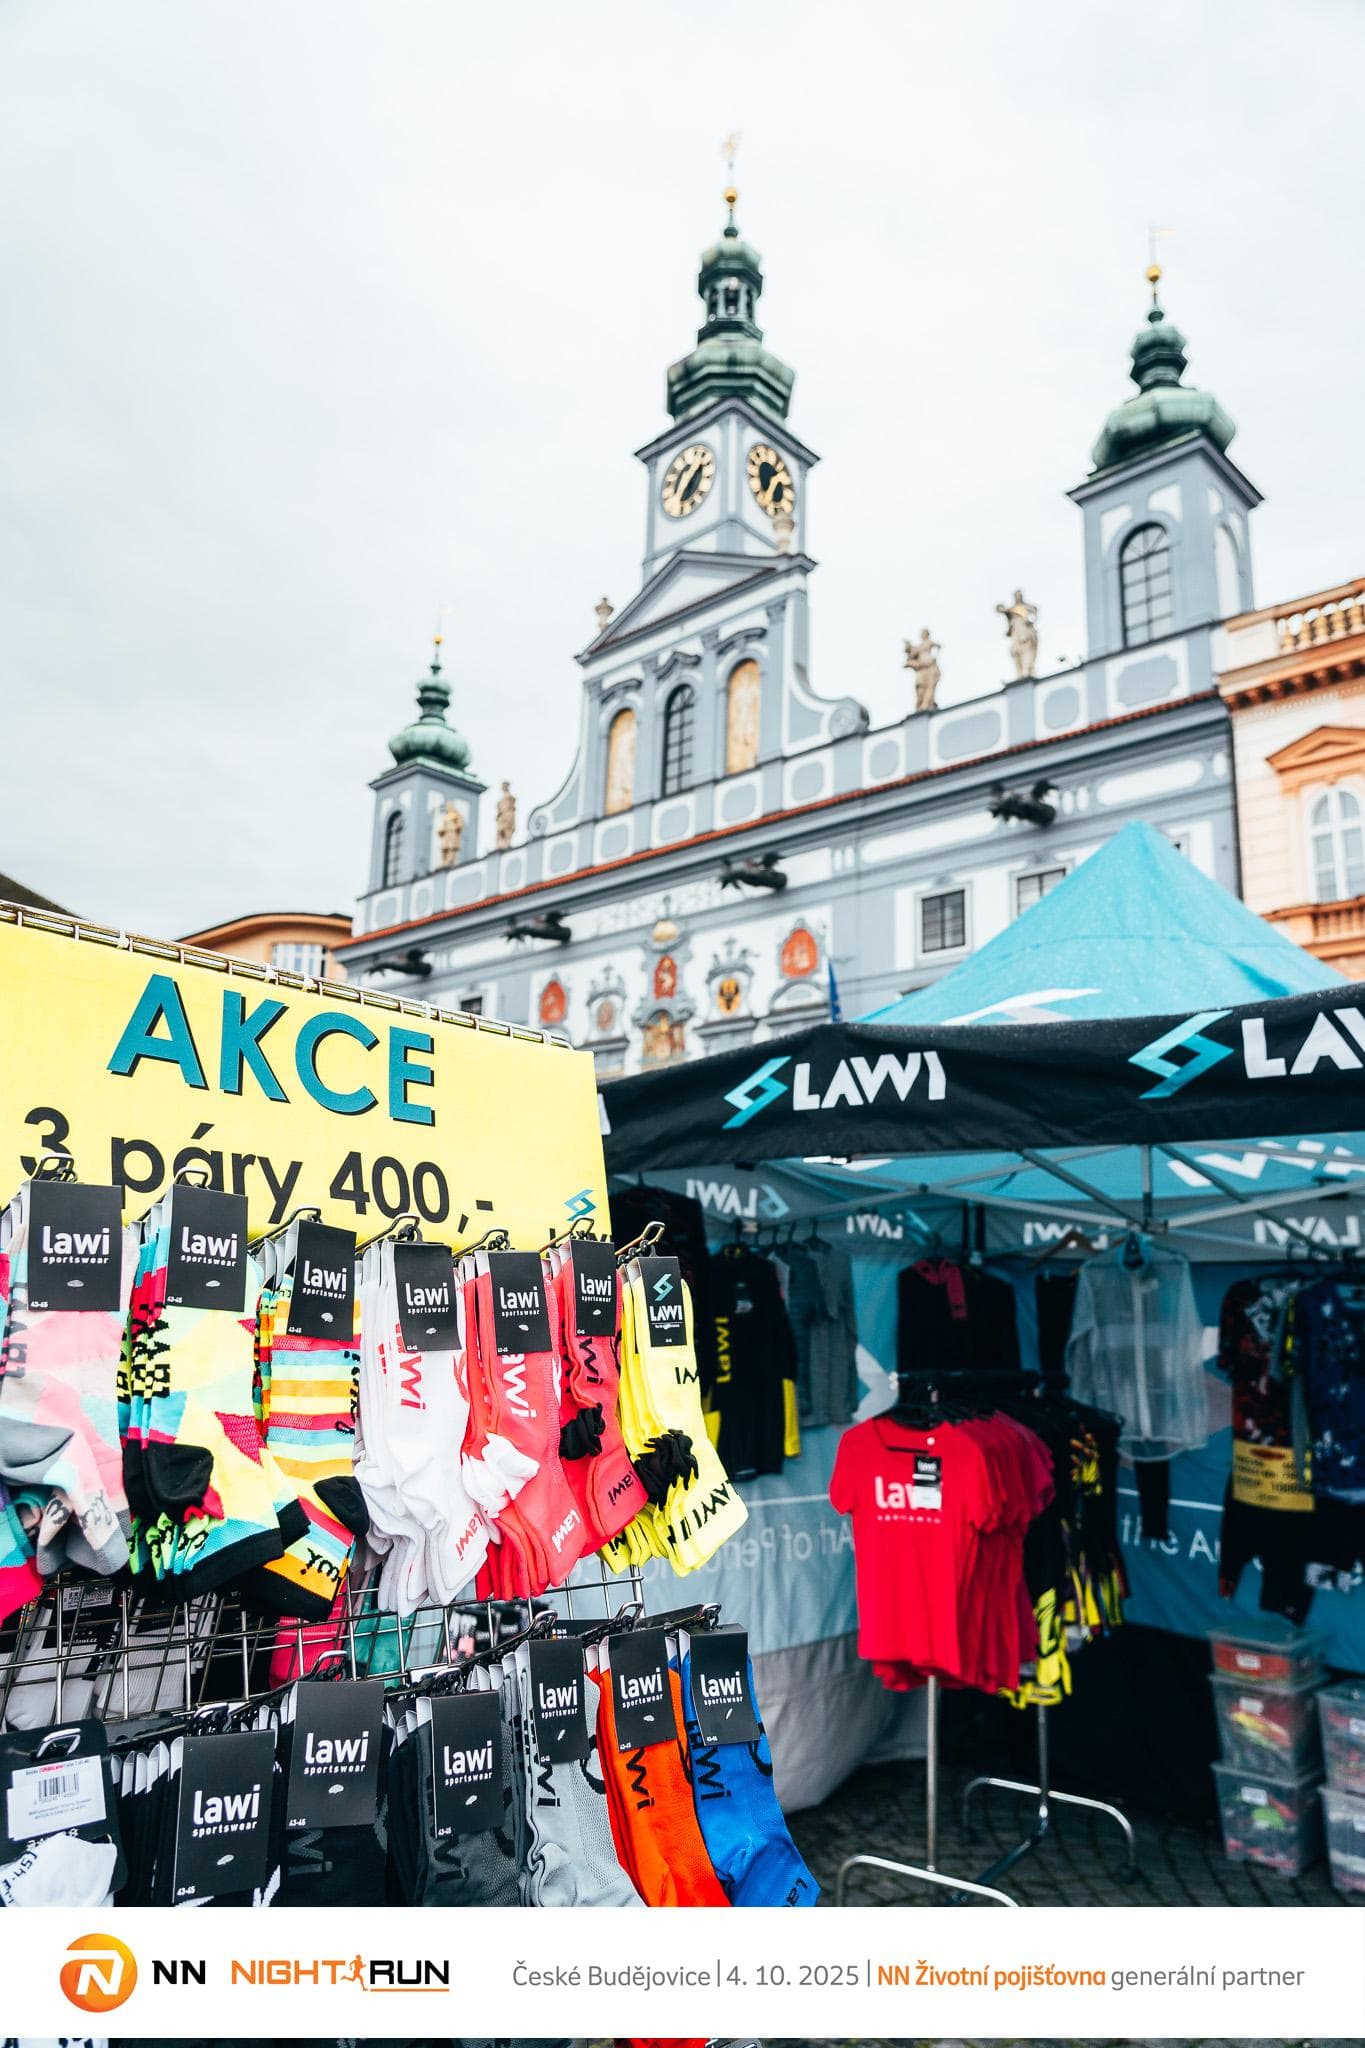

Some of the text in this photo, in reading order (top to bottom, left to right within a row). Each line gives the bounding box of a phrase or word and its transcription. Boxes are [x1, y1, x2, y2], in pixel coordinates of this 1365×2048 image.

[106, 973, 435, 1127] AKCE
[792, 1050, 947, 1111] LAWI
[20, 1106, 72, 1182] 3
[111, 1122, 303, 1225] páry
[42, 1226, 110, 1256] lawi
[181, 1226, 238, 1259] lawi
[42, 1255, 109, 1265] sportswear
[181, 1253, 237, 1267] sportswear
[303, 1260, 348, 1293] lawi
[580, 1273, 612, 1297] lawi
[302, 1286, 346, 1300] sportswear
[405, 1282, 449, 1307] lawi
[500, 1286, 539, 1309] lawi
[407, 1306, 449, 1315] sportswear
[501, 1308, 540, 1317] sportswear
[650, 1305, 683, 1321] LAWI
[455, 1512, 485, 1560] lawi
[539, 1679, 578, 1710] lawi
[620, 1667, 663, 1699] lawi
[700, 1670, 742, 1699] lawi
[622, 1693, 664, 1709] sportswear
[704, 1695, 743, 1707] sportswear
[541, 1708, 577, 1719] sportswear
[305, 1731, 370, 1765] lawi
[444, 1739, 493, 1776] lawi
[304, 1763, 366, 1776] sportswear
[444, 1771, 493, 1787] sportswear
[193, 1784, 261, 1825] lawi
[192, 1820, 258, 1838] sportswear
